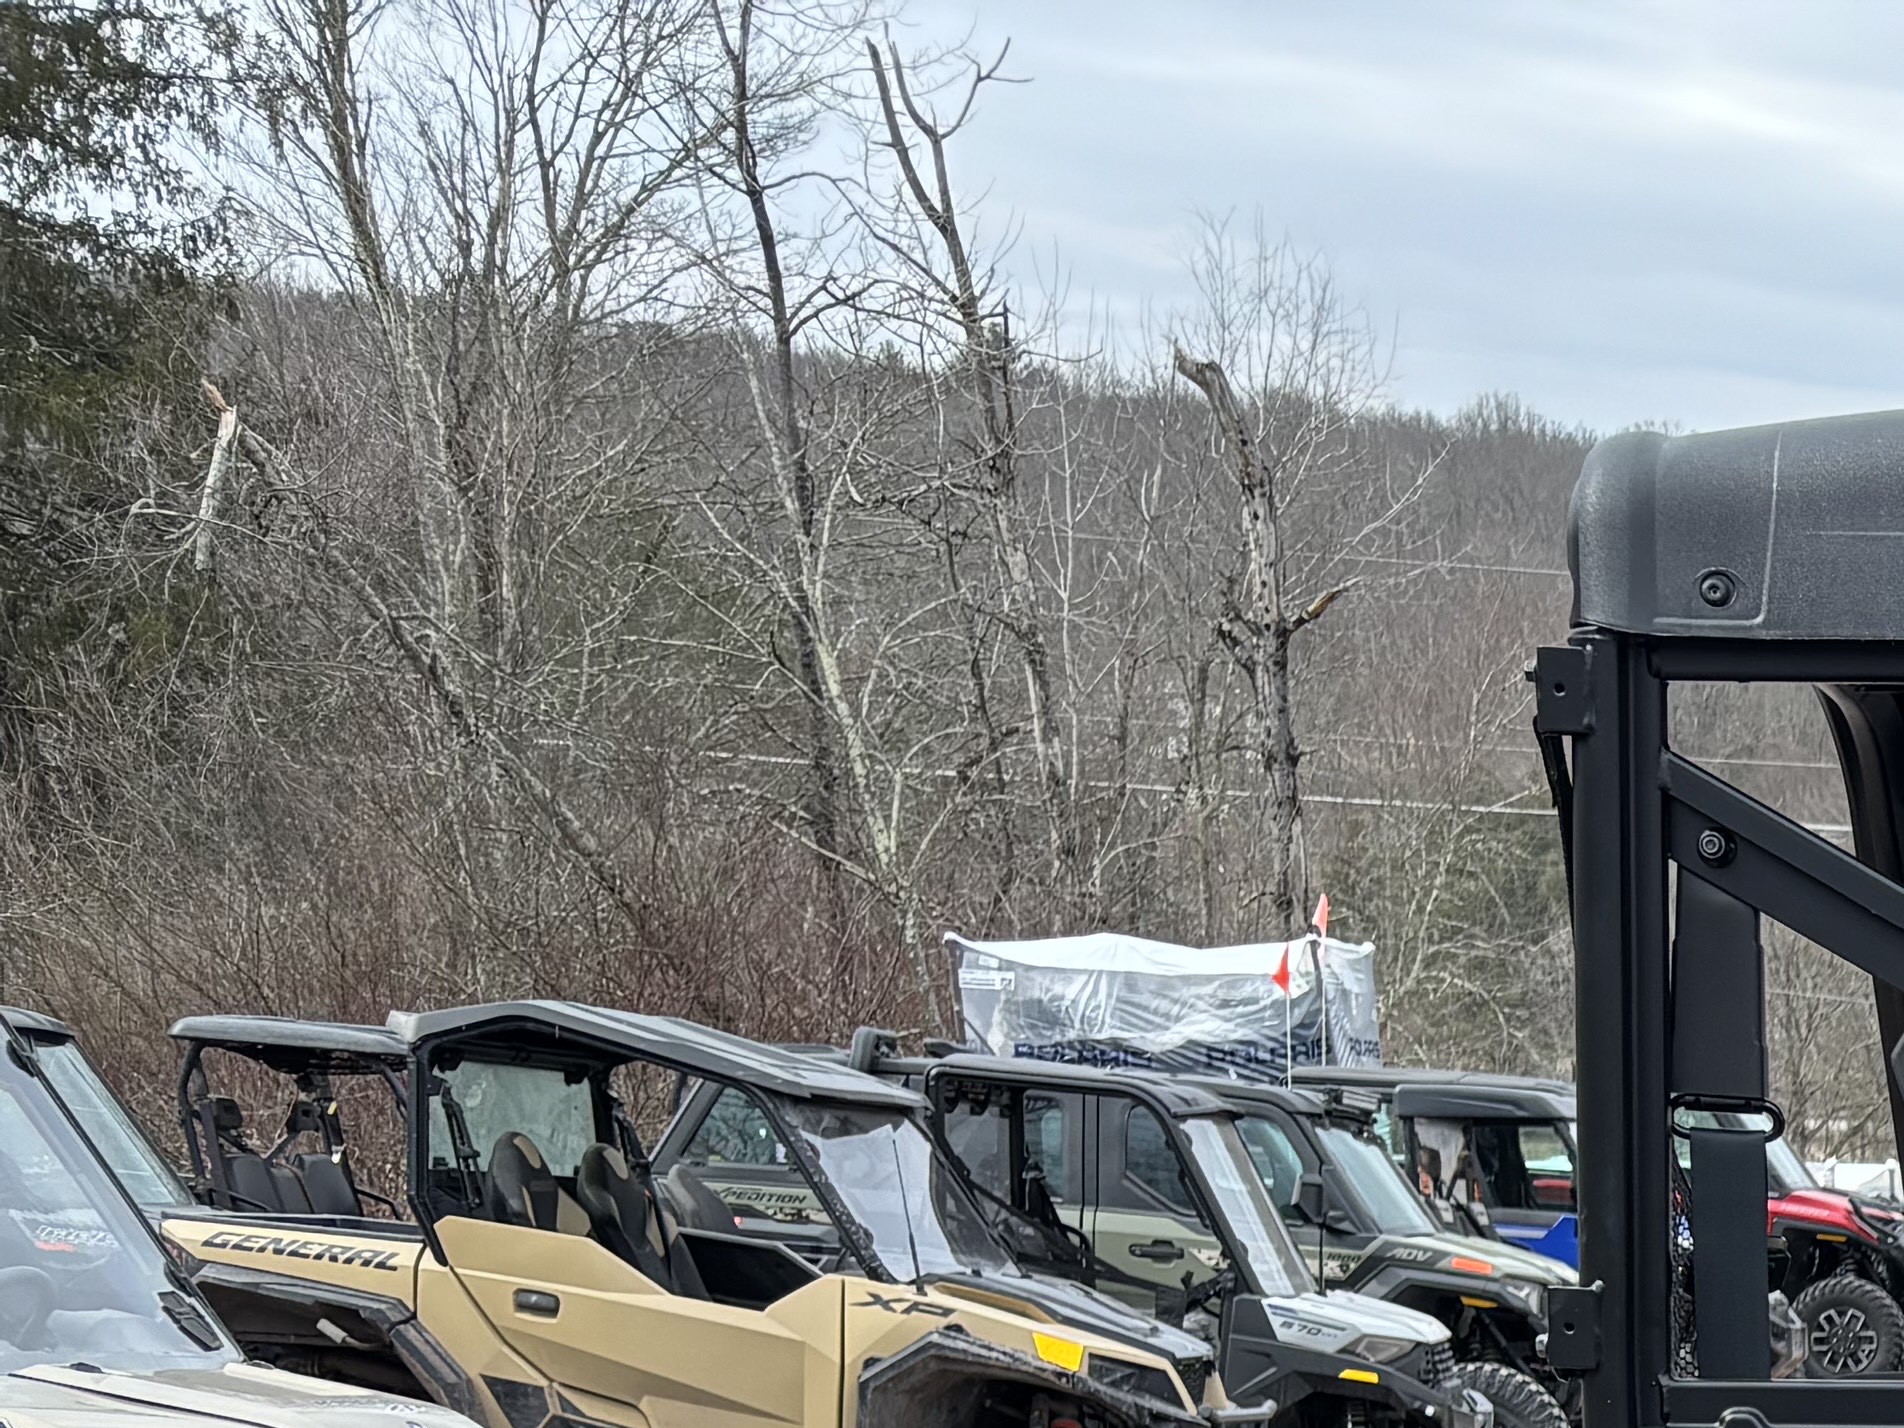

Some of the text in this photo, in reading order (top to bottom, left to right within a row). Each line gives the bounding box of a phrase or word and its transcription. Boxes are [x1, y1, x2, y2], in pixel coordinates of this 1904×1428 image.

[201, 1231, 400, 1272] GENERAL
[1385, 1247, 1433, 1262] ADV
[848, 1291, 958, 1318] XP
